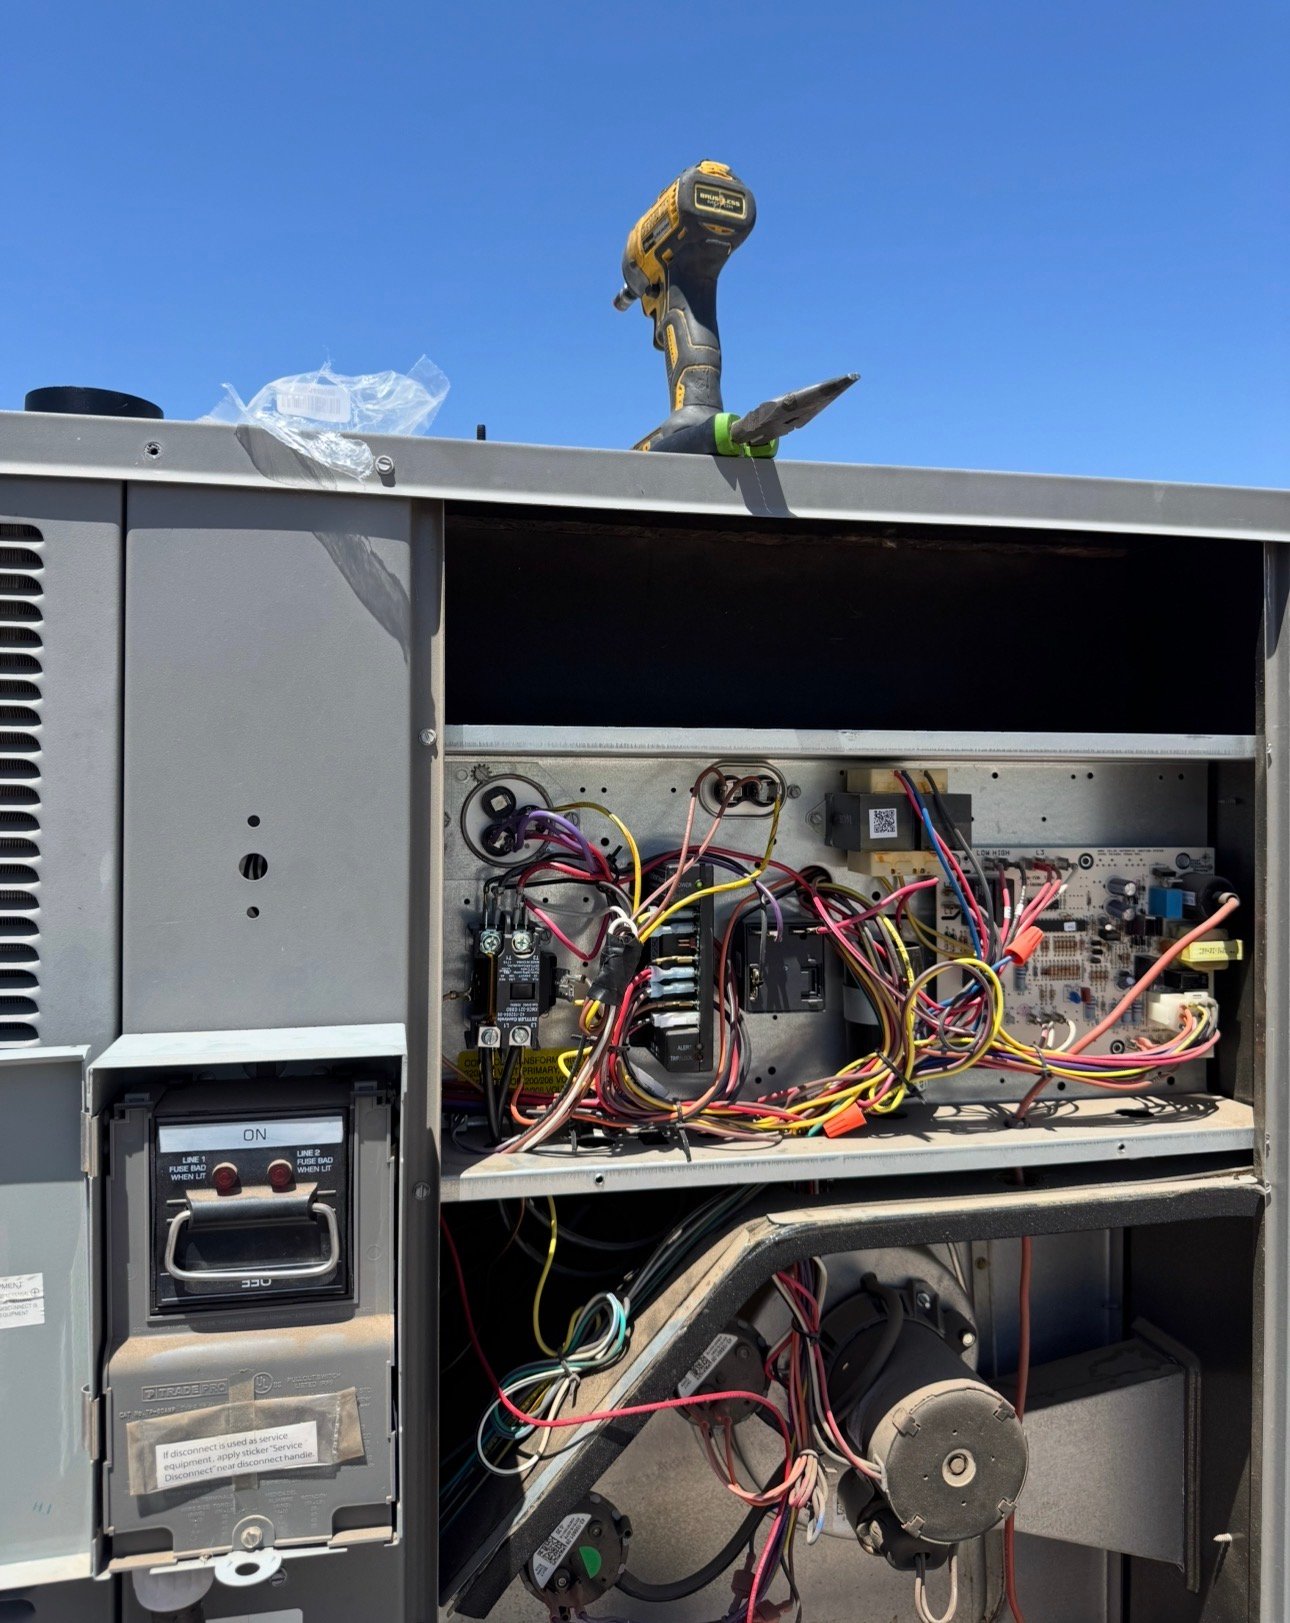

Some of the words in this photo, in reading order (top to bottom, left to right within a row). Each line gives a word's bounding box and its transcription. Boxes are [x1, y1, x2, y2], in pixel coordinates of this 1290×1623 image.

[243, 1128, 267, 1141] ON
[242, 1278, 272, 1288] OFF
[158, 1385, 200, 1397] TRADE
[201, 1382, 226, 1393] PRO
[163, 1451, 169, 1459] If
[170, 1444, 217, 1458] disconnect
[219, 1441, 226, 1450] is
[227, 1438, 246, 1448] used
[259, 1433, 288, 1443] service
[217, 1451, 240, 1464] apply
[242, 1446, 268, 1456] sticker
[217, 1463, 235, 1472] near
[237, 1454, 283, 1468] disconnect
[284, 1451, 315, 1462] handle.
